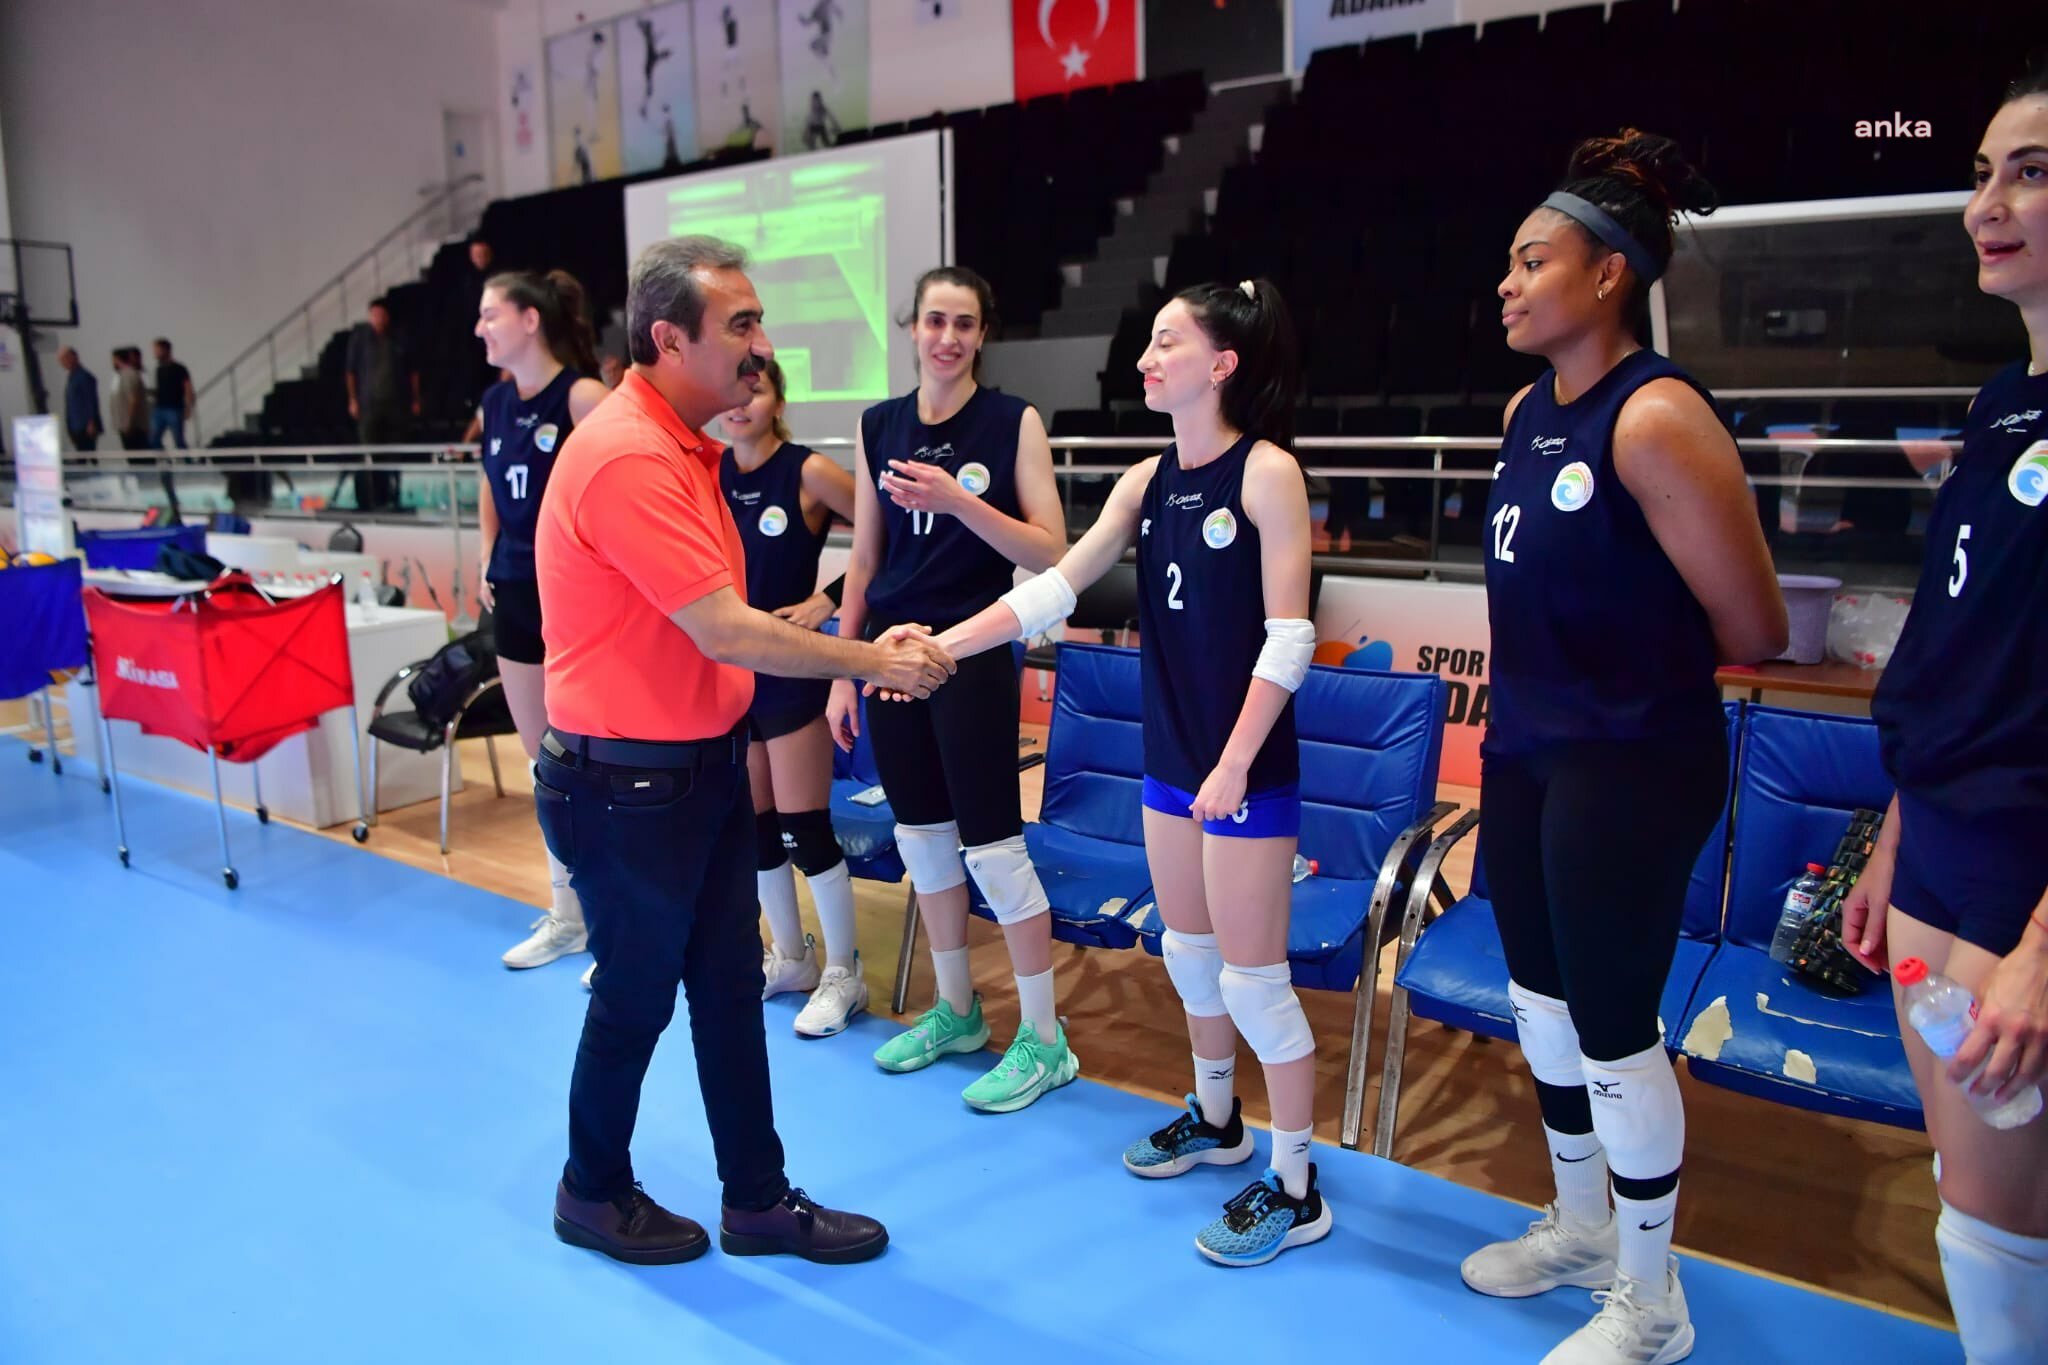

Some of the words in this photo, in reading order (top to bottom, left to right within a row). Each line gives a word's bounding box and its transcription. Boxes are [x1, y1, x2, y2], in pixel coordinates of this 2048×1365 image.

[505, 464, 528, 500] 17
[1492, 503, 1520, 563] 12
[1948, 524, 1971, 598] 5
[1166, 562, 1184, 610] 2
[1416, 645, 1485, 677] SPOR
